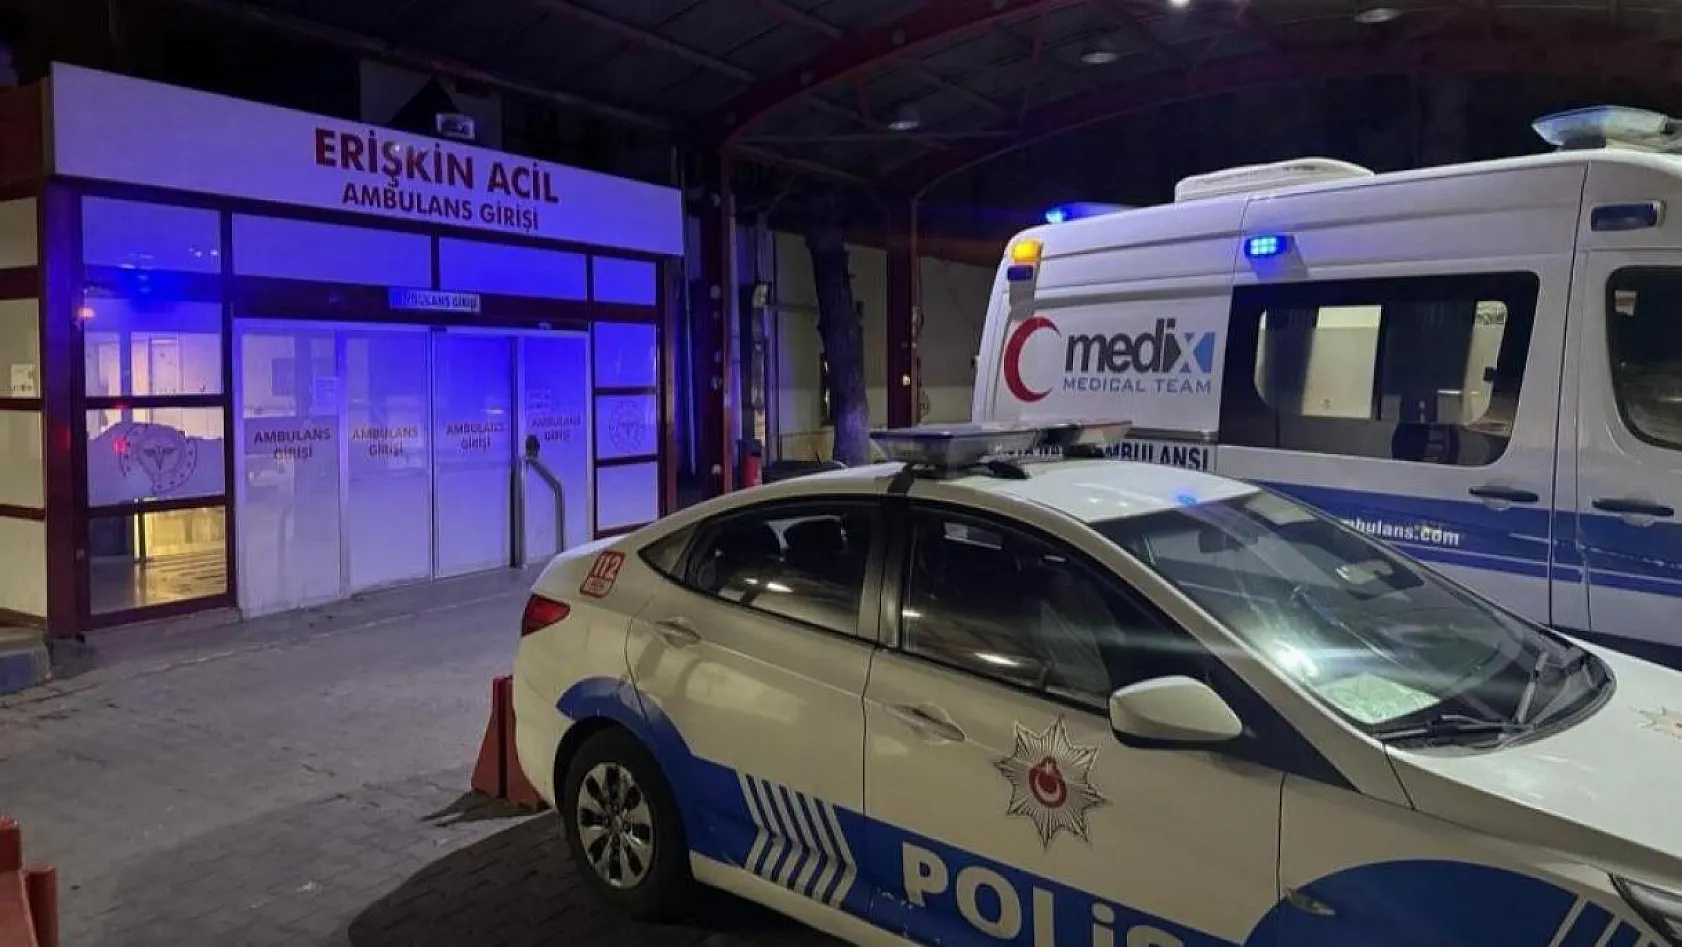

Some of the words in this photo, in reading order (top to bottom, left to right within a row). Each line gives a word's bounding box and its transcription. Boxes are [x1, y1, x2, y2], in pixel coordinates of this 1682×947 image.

[487, 163, 559, 203] ACİL
[343, 182, 472, 220] AMBULANS
[1063, 377, 1146, 393] MEDICAL
[1153, 379, 1212, 394] TEAM
[253, 427, 331, 444] AMBULANS
